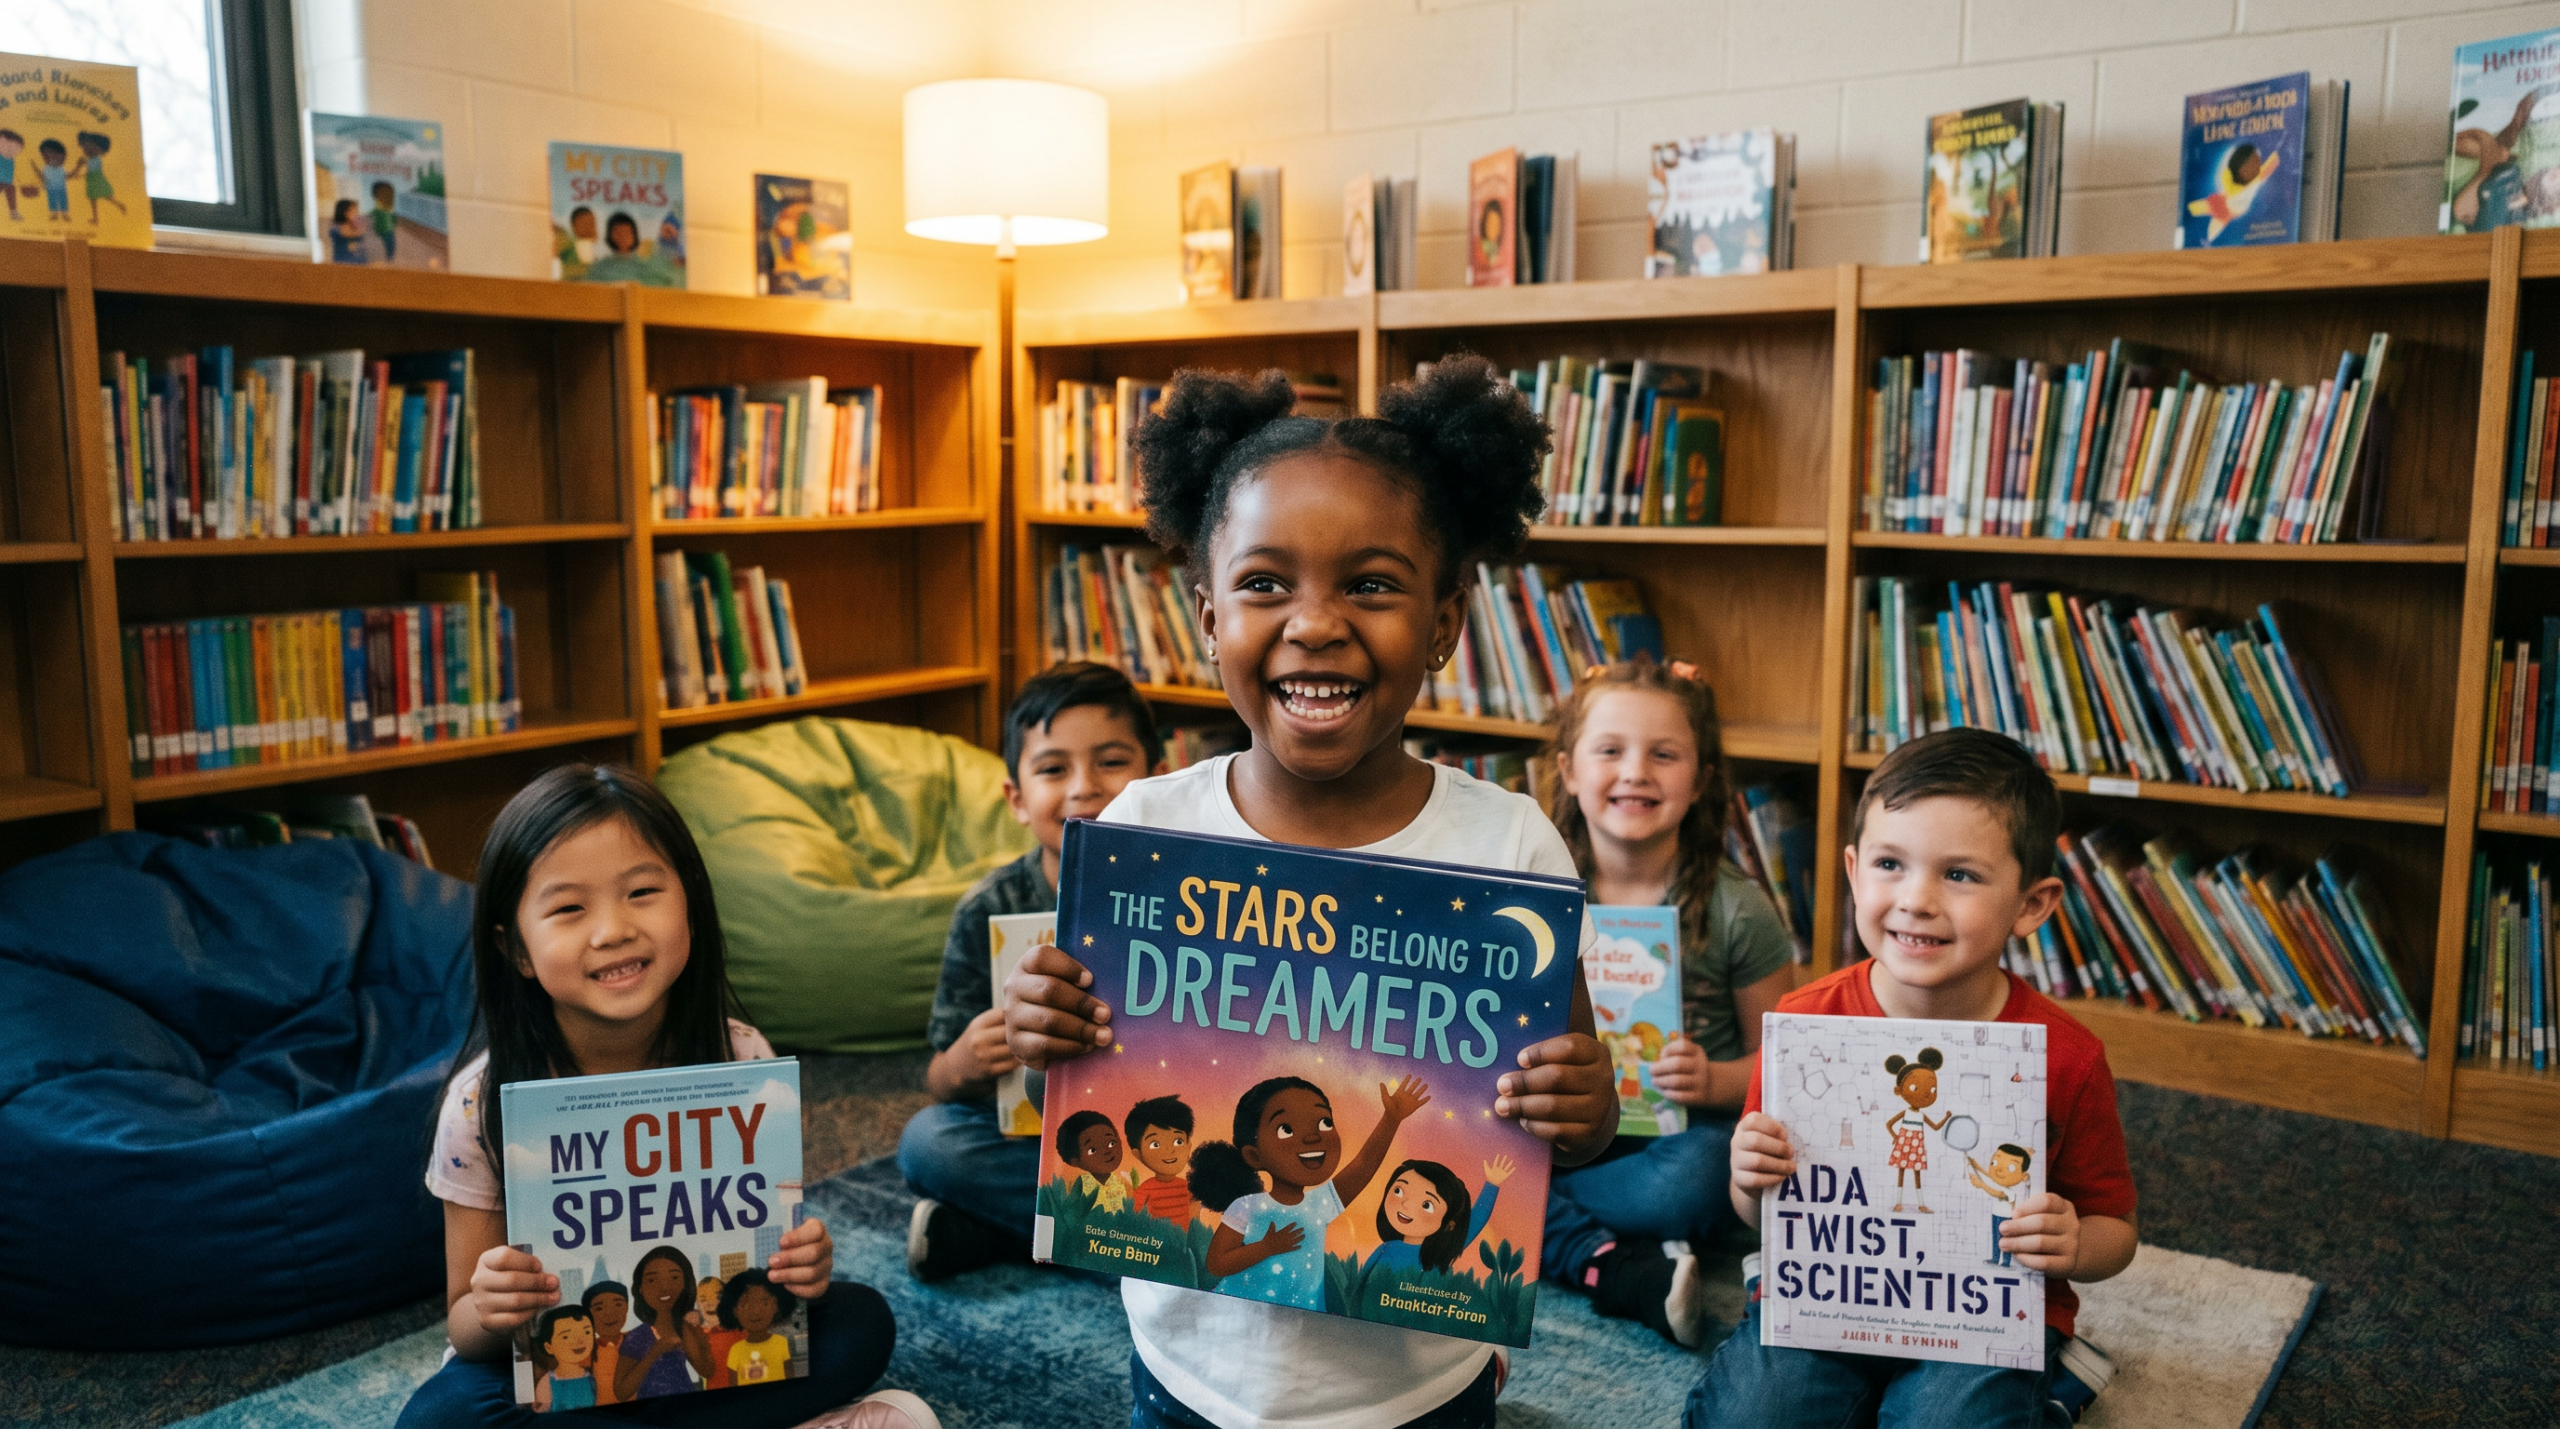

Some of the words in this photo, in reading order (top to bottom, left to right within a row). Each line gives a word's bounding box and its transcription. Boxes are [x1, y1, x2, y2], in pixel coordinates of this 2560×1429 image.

[564, 149, 604, 175] MY
[612, 153, 669, 182] CITY
[570, 177, 669, 208] SPEAKS
[1109, 891, 1165, 931] THE
[1175, 876, 1339, 955] STARS
[1350, 924, 1469, 975] BELONG
[1481, 943, 1520, 981] TO
[1125, 939, 1501, 1069] DREAMERS
[550, 1130, 610, 1174] MY
[623, 1103, 767, 1178] CITY
[552, 1172, 768, 1250] SPEAKS
[1777, 1164, 1868, 1207] ADA
[1151, 1236, 1164, 1249] by
[1777, 1210, 1926, 1266] TWIST,
[1777, 1260, 2020, 1318] SCIENTIST
